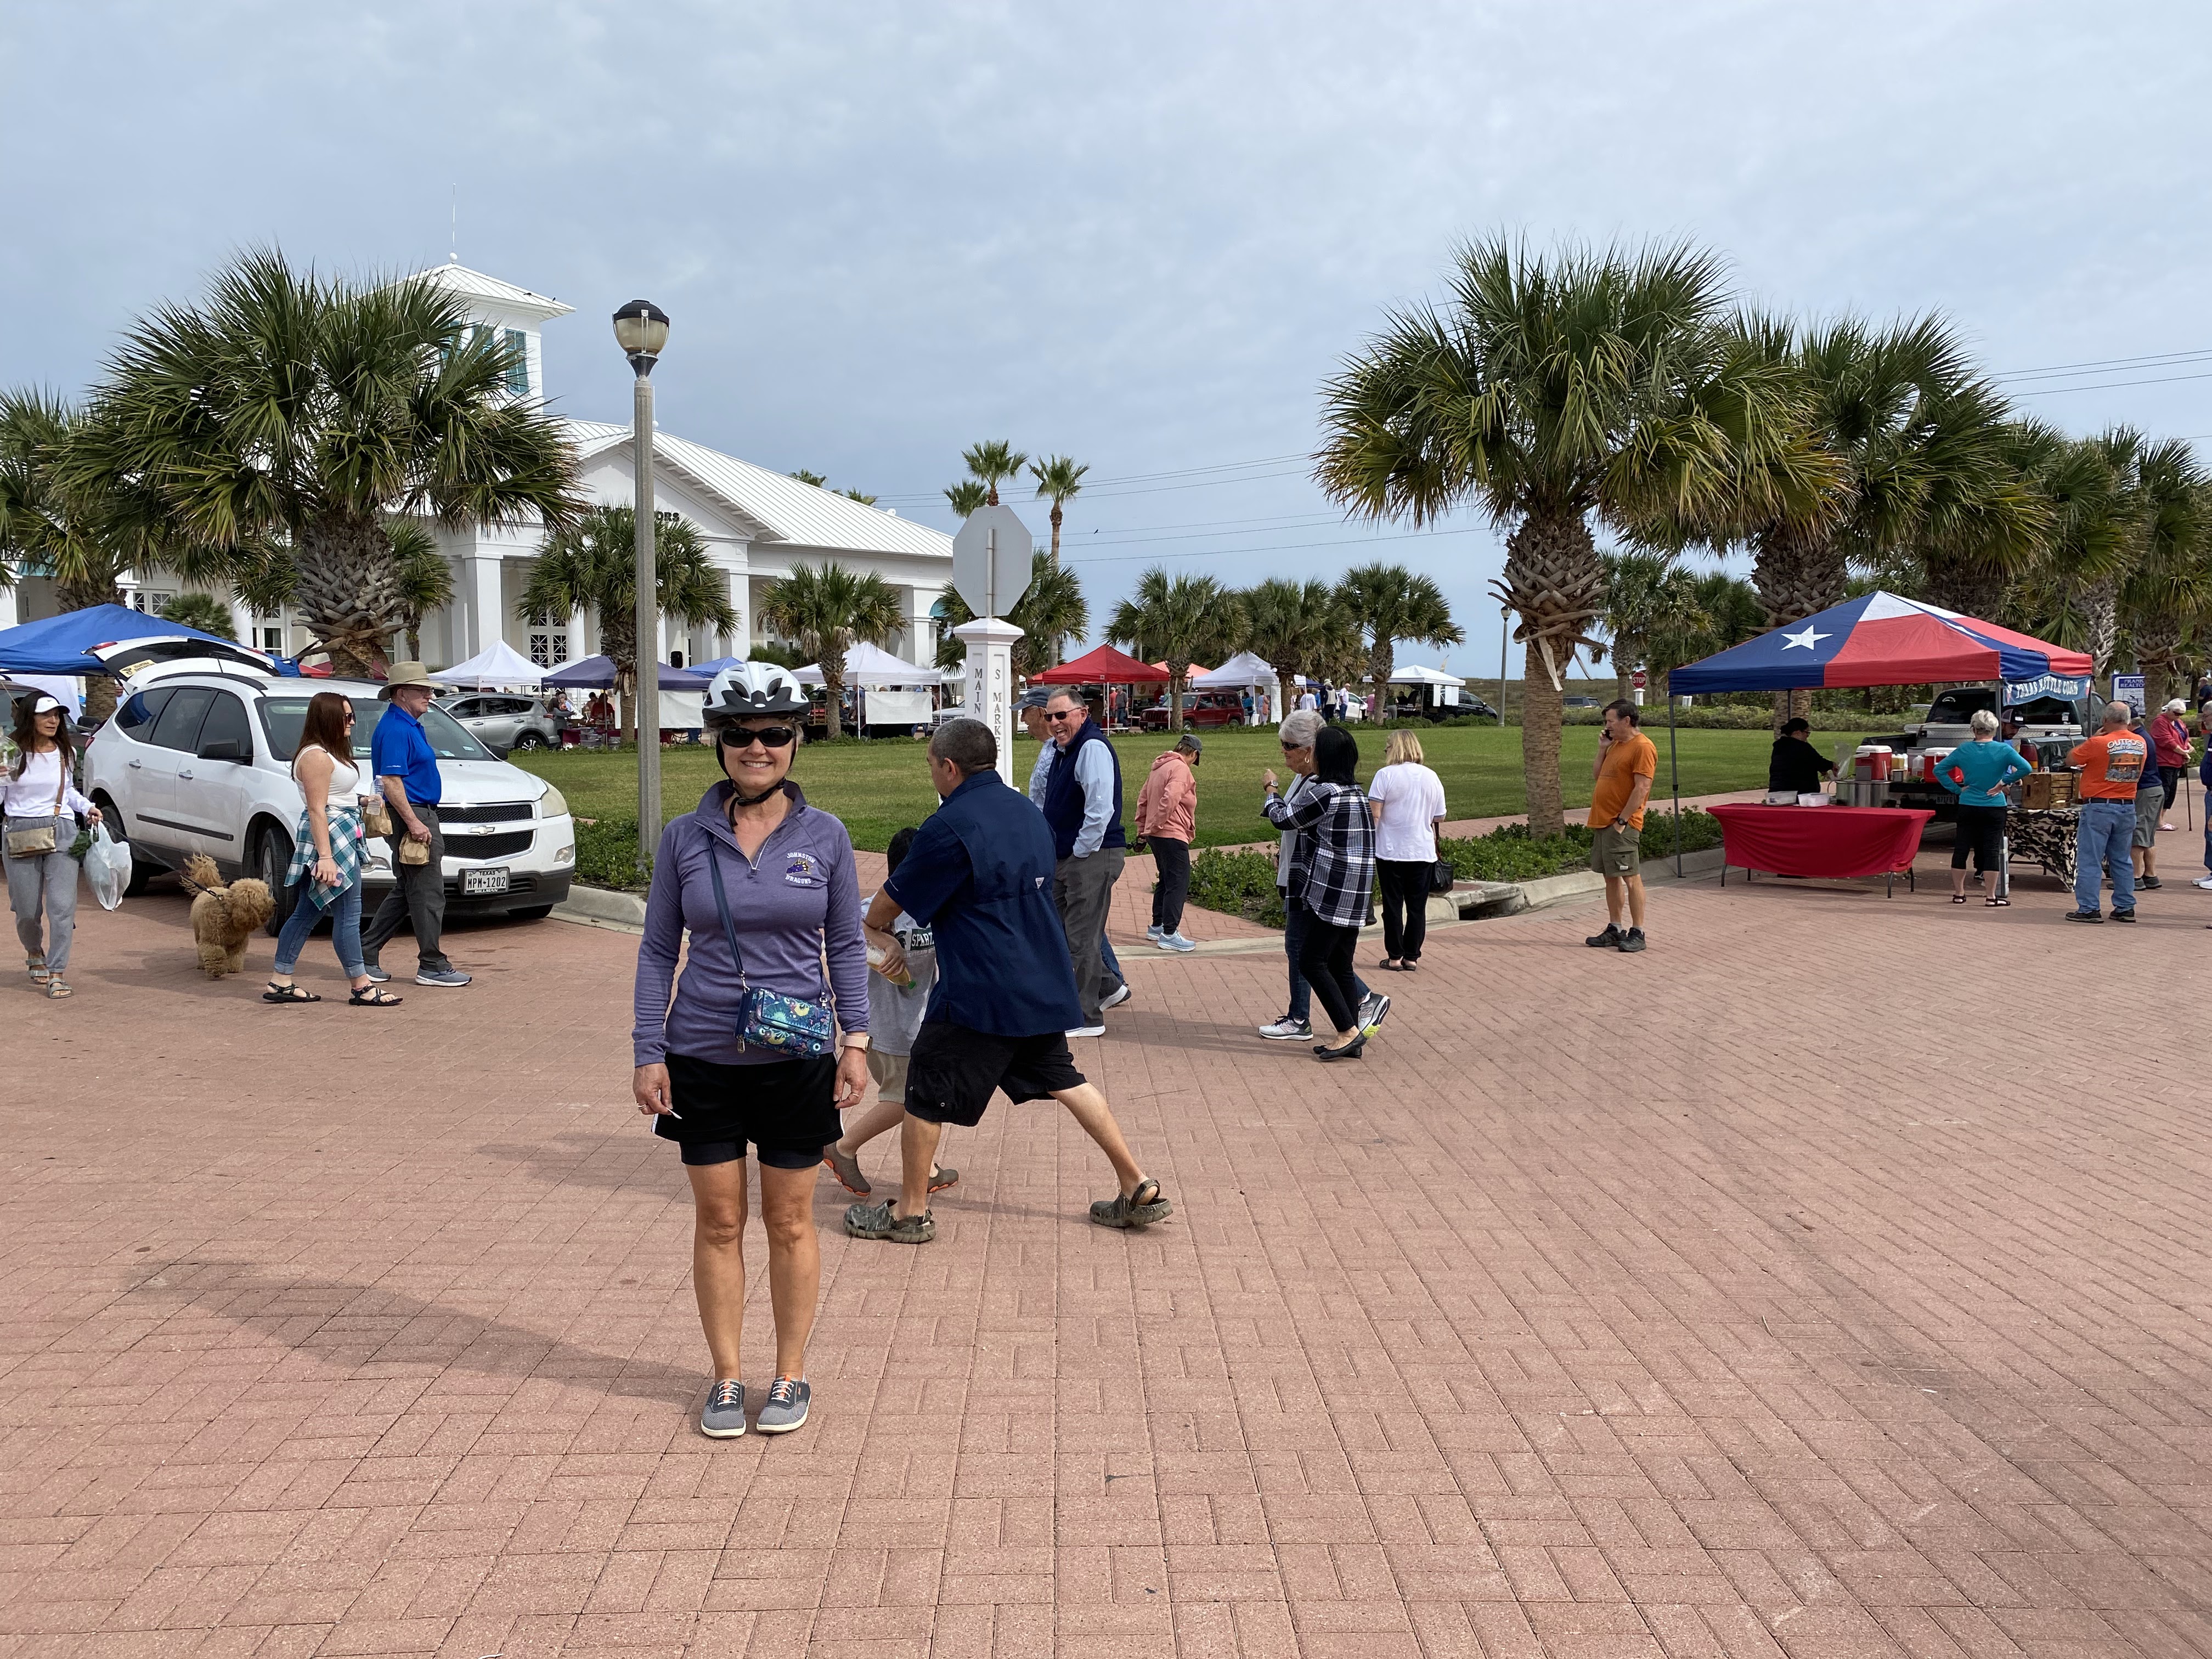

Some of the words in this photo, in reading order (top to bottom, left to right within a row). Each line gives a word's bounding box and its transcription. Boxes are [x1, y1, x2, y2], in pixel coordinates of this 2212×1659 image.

[995, 669, 1001, 680] S
[974, 668, 983, 714] MAIN
[2016, 681, 2038, 699] TEXAS
[2038, 675, 2062, 694] KETTLE
[2063, 680, 2078, 695] CORN
[787, 852, 816, 864] JOHNSTON
[785, 874, 812, 884] DRAGONS
